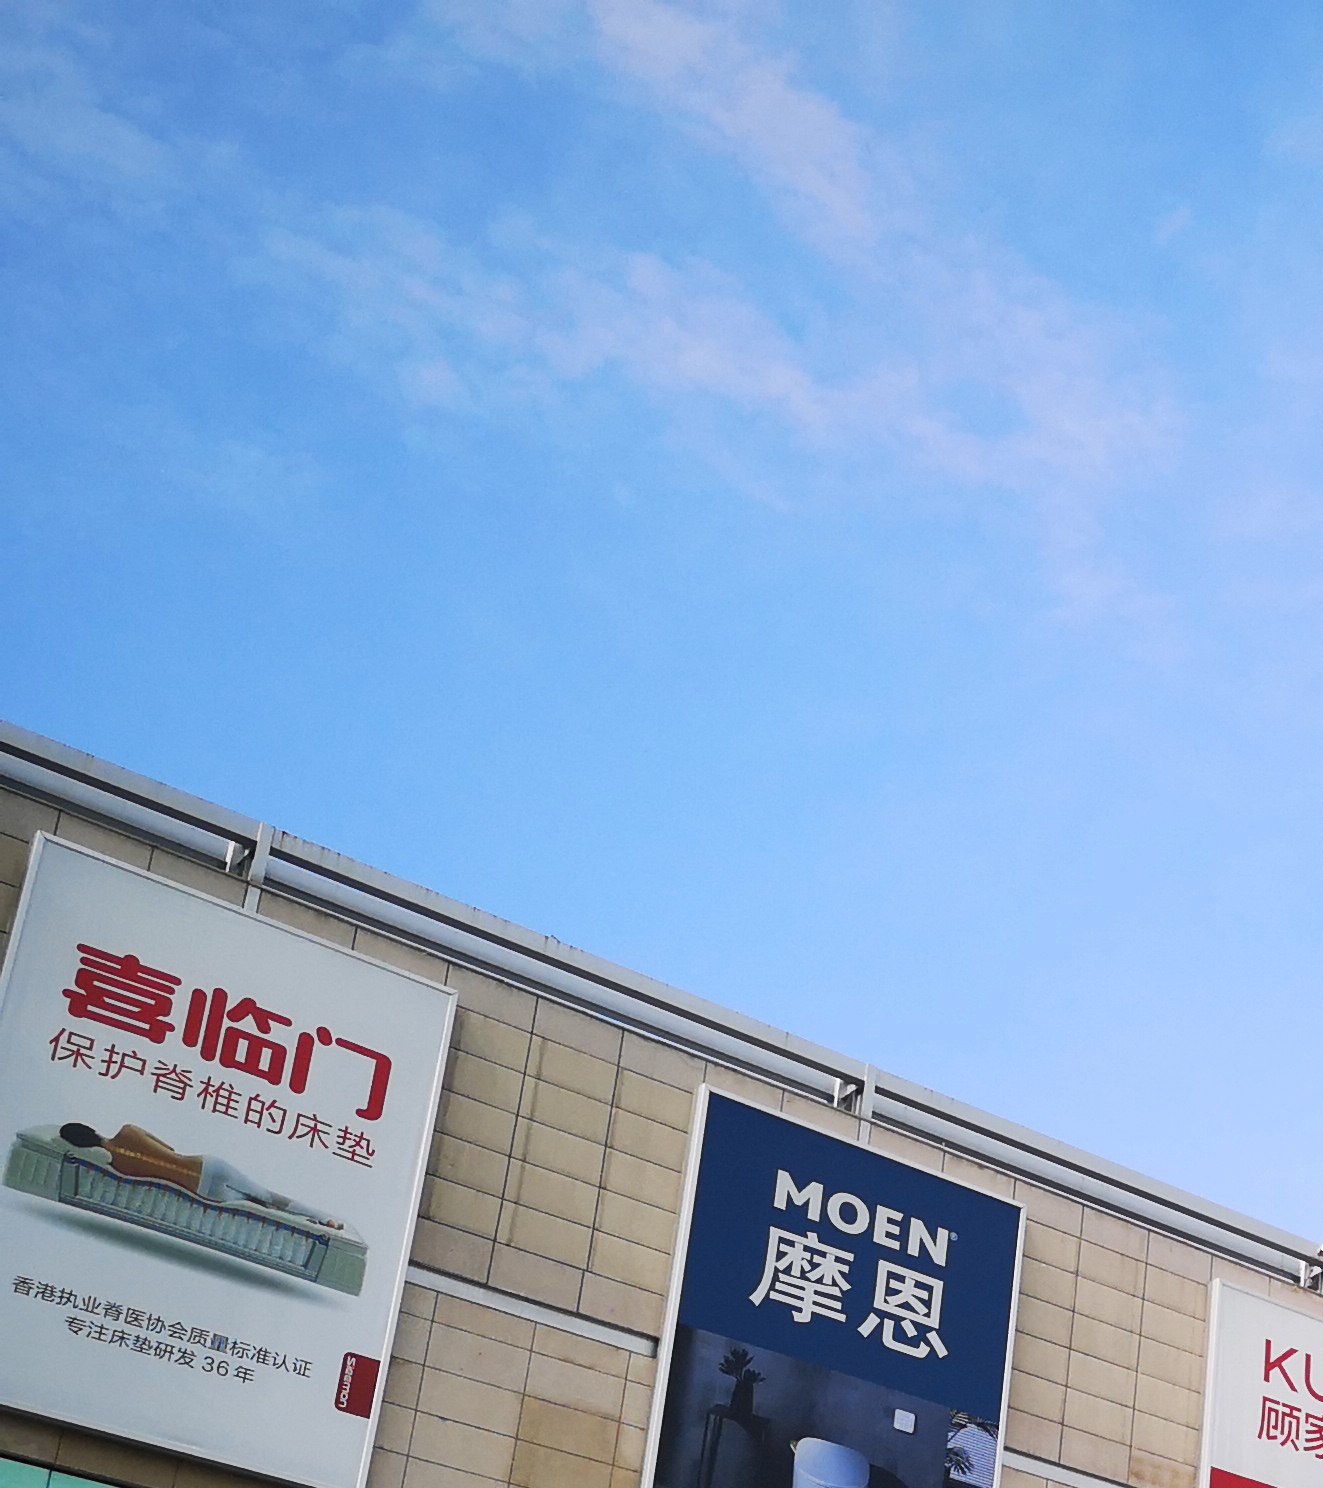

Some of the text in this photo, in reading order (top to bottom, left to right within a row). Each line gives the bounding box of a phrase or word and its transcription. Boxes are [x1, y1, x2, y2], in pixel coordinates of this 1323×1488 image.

[63, 943, 391, 1121] 喜临门
[49, 1027, 375, 1169] 保护脊椎的床垫
[773, 1169, 950, 1267] MOEN
[12, 1275, 313, 1381] 香港执业脊医协会质量标准认证
[64, 1315, 256, 1385] 专注床垫研发 36 年
[749, 1224, 951, 1361] 摩恩
